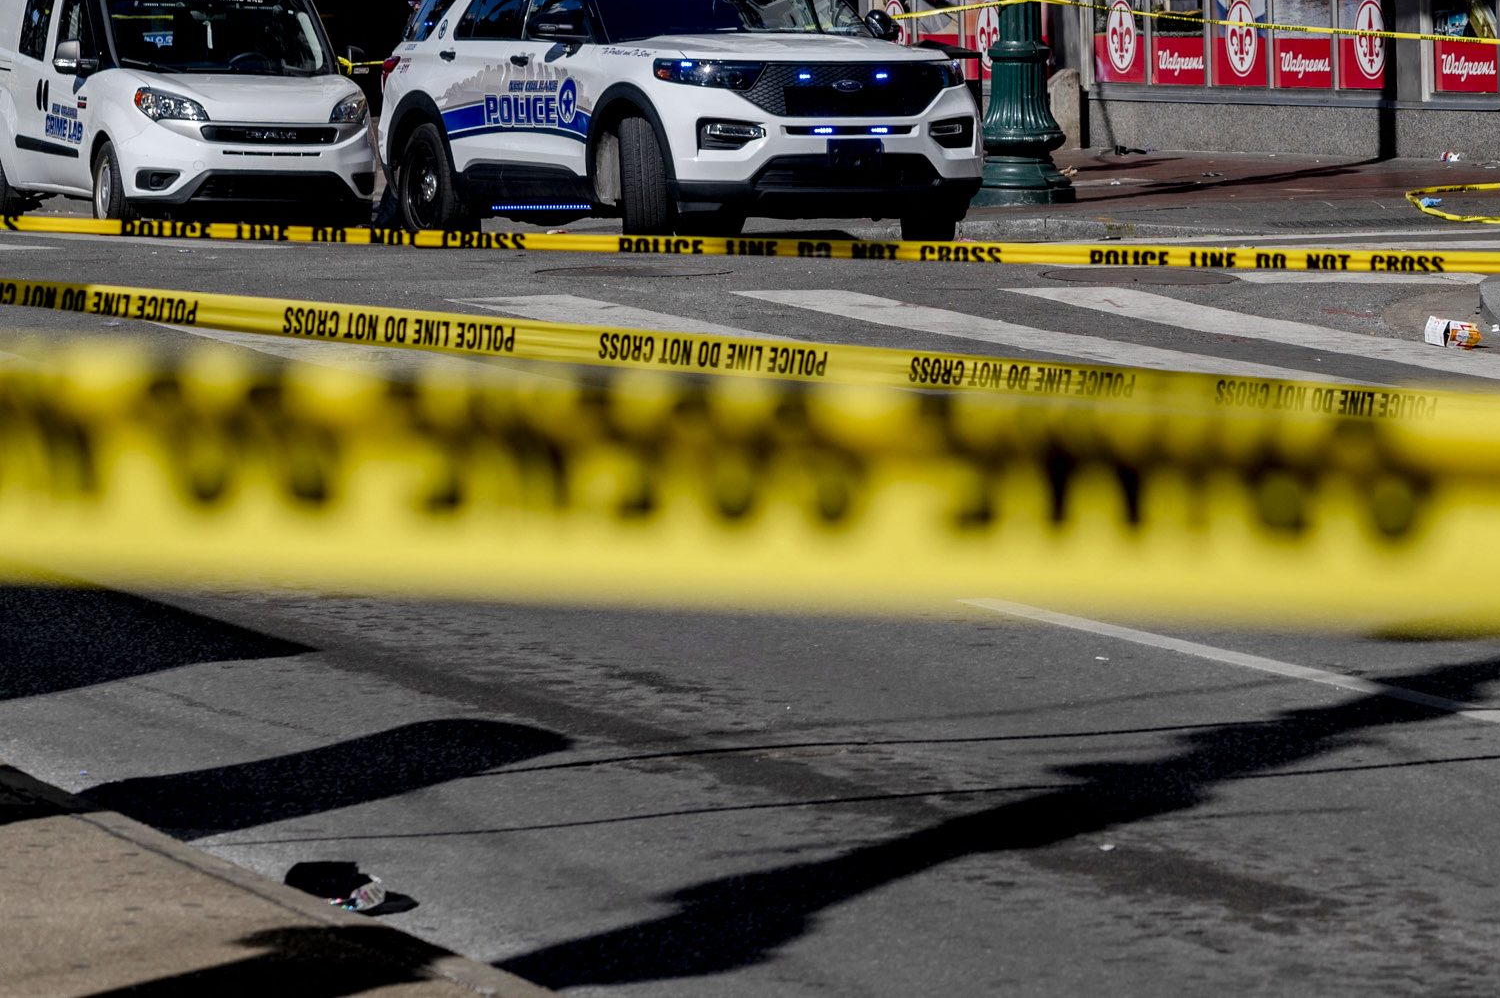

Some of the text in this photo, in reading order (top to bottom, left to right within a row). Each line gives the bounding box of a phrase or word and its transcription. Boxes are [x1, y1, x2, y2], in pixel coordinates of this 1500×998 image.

[1158, 49, 1204, 77] Walgreens
[1280, 51, 1331, 79] Walgreens
[1441, 52, 1496, 82] Walgreens
[509, 80, 559, 92] NEW ORLEANS
[484, 94, 559, 127] POLICE
[45, 114, 83, 144] CRIME LAB
[618, 237, 703, 255] POLICE
[726, 239, 778, 256] LINE
[920, 245, 1002, 263] CROSS
[1089, 249, 1169, 266] POLICE
[1190, 251, 1236, 268] LINE
[1306, 254, 1350, 270] NOT
[1370, 255, 1445, 272] CROSS
[23, 285, 57, 309] NOT
[61, 288, 87, 313] DO
[92, 291, 131, 317] LINE
[134, 295, 199, 325] POLICE
[283, 306, 516, 352] POLICE LINE DO NOT CROSS
[598, 332, 828, 377] POLICE LINE DO NOT CROSS
[908, 356, 1136, 398] POLICE LINE DO NOT CROSS
[1214, 379, 1438, 421] POLICE LINE DO NOT CROSS
